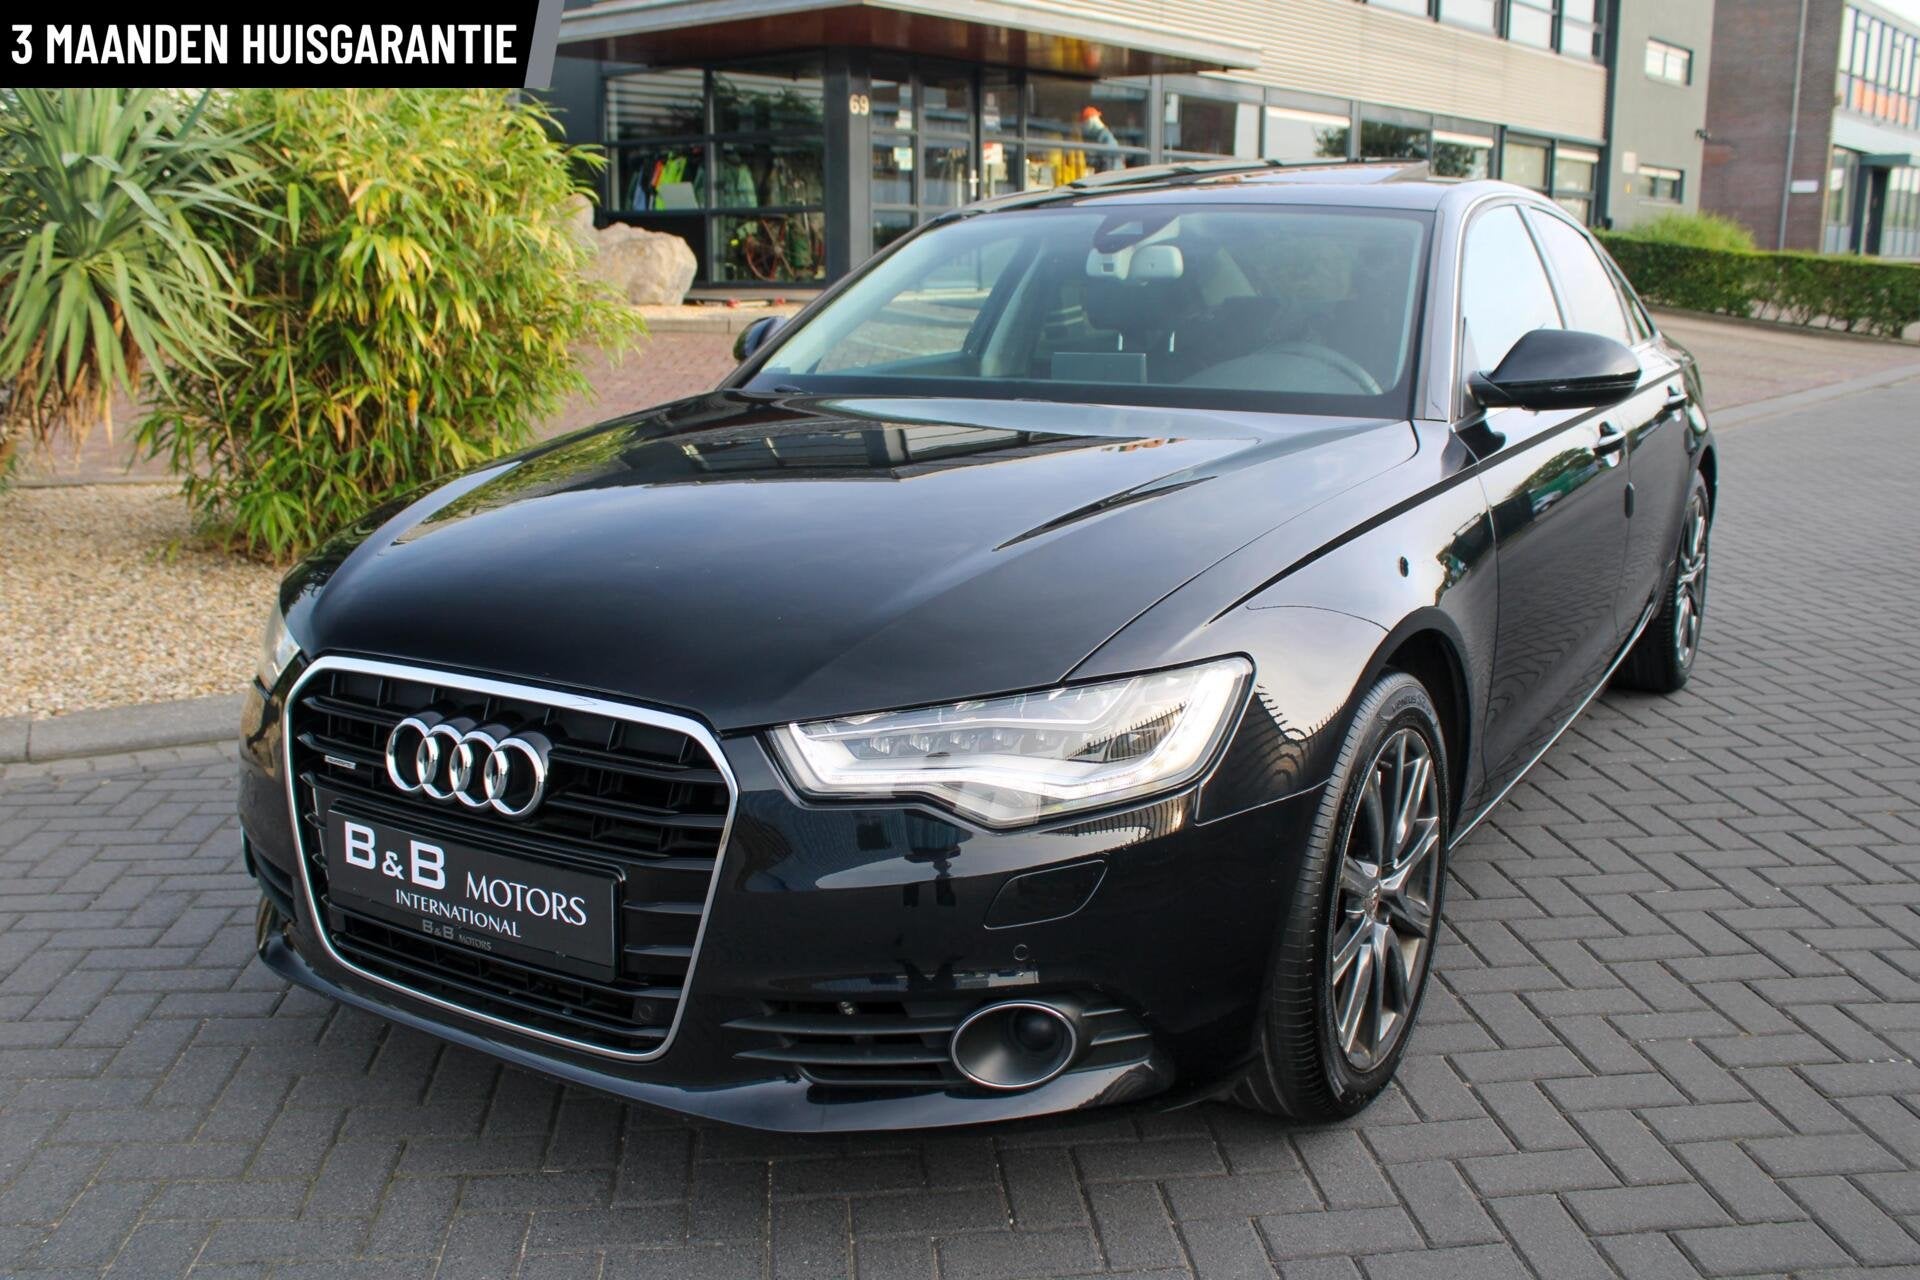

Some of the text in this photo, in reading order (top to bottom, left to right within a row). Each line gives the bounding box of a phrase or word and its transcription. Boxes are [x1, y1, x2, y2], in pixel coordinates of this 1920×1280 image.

[849, 94, 870, 116] 69
[395, 888, 522, 938] INTERNATIONAL
[466, 871, 588, 926] MOTORS
[459, 934, 492, 951] MOTORS
